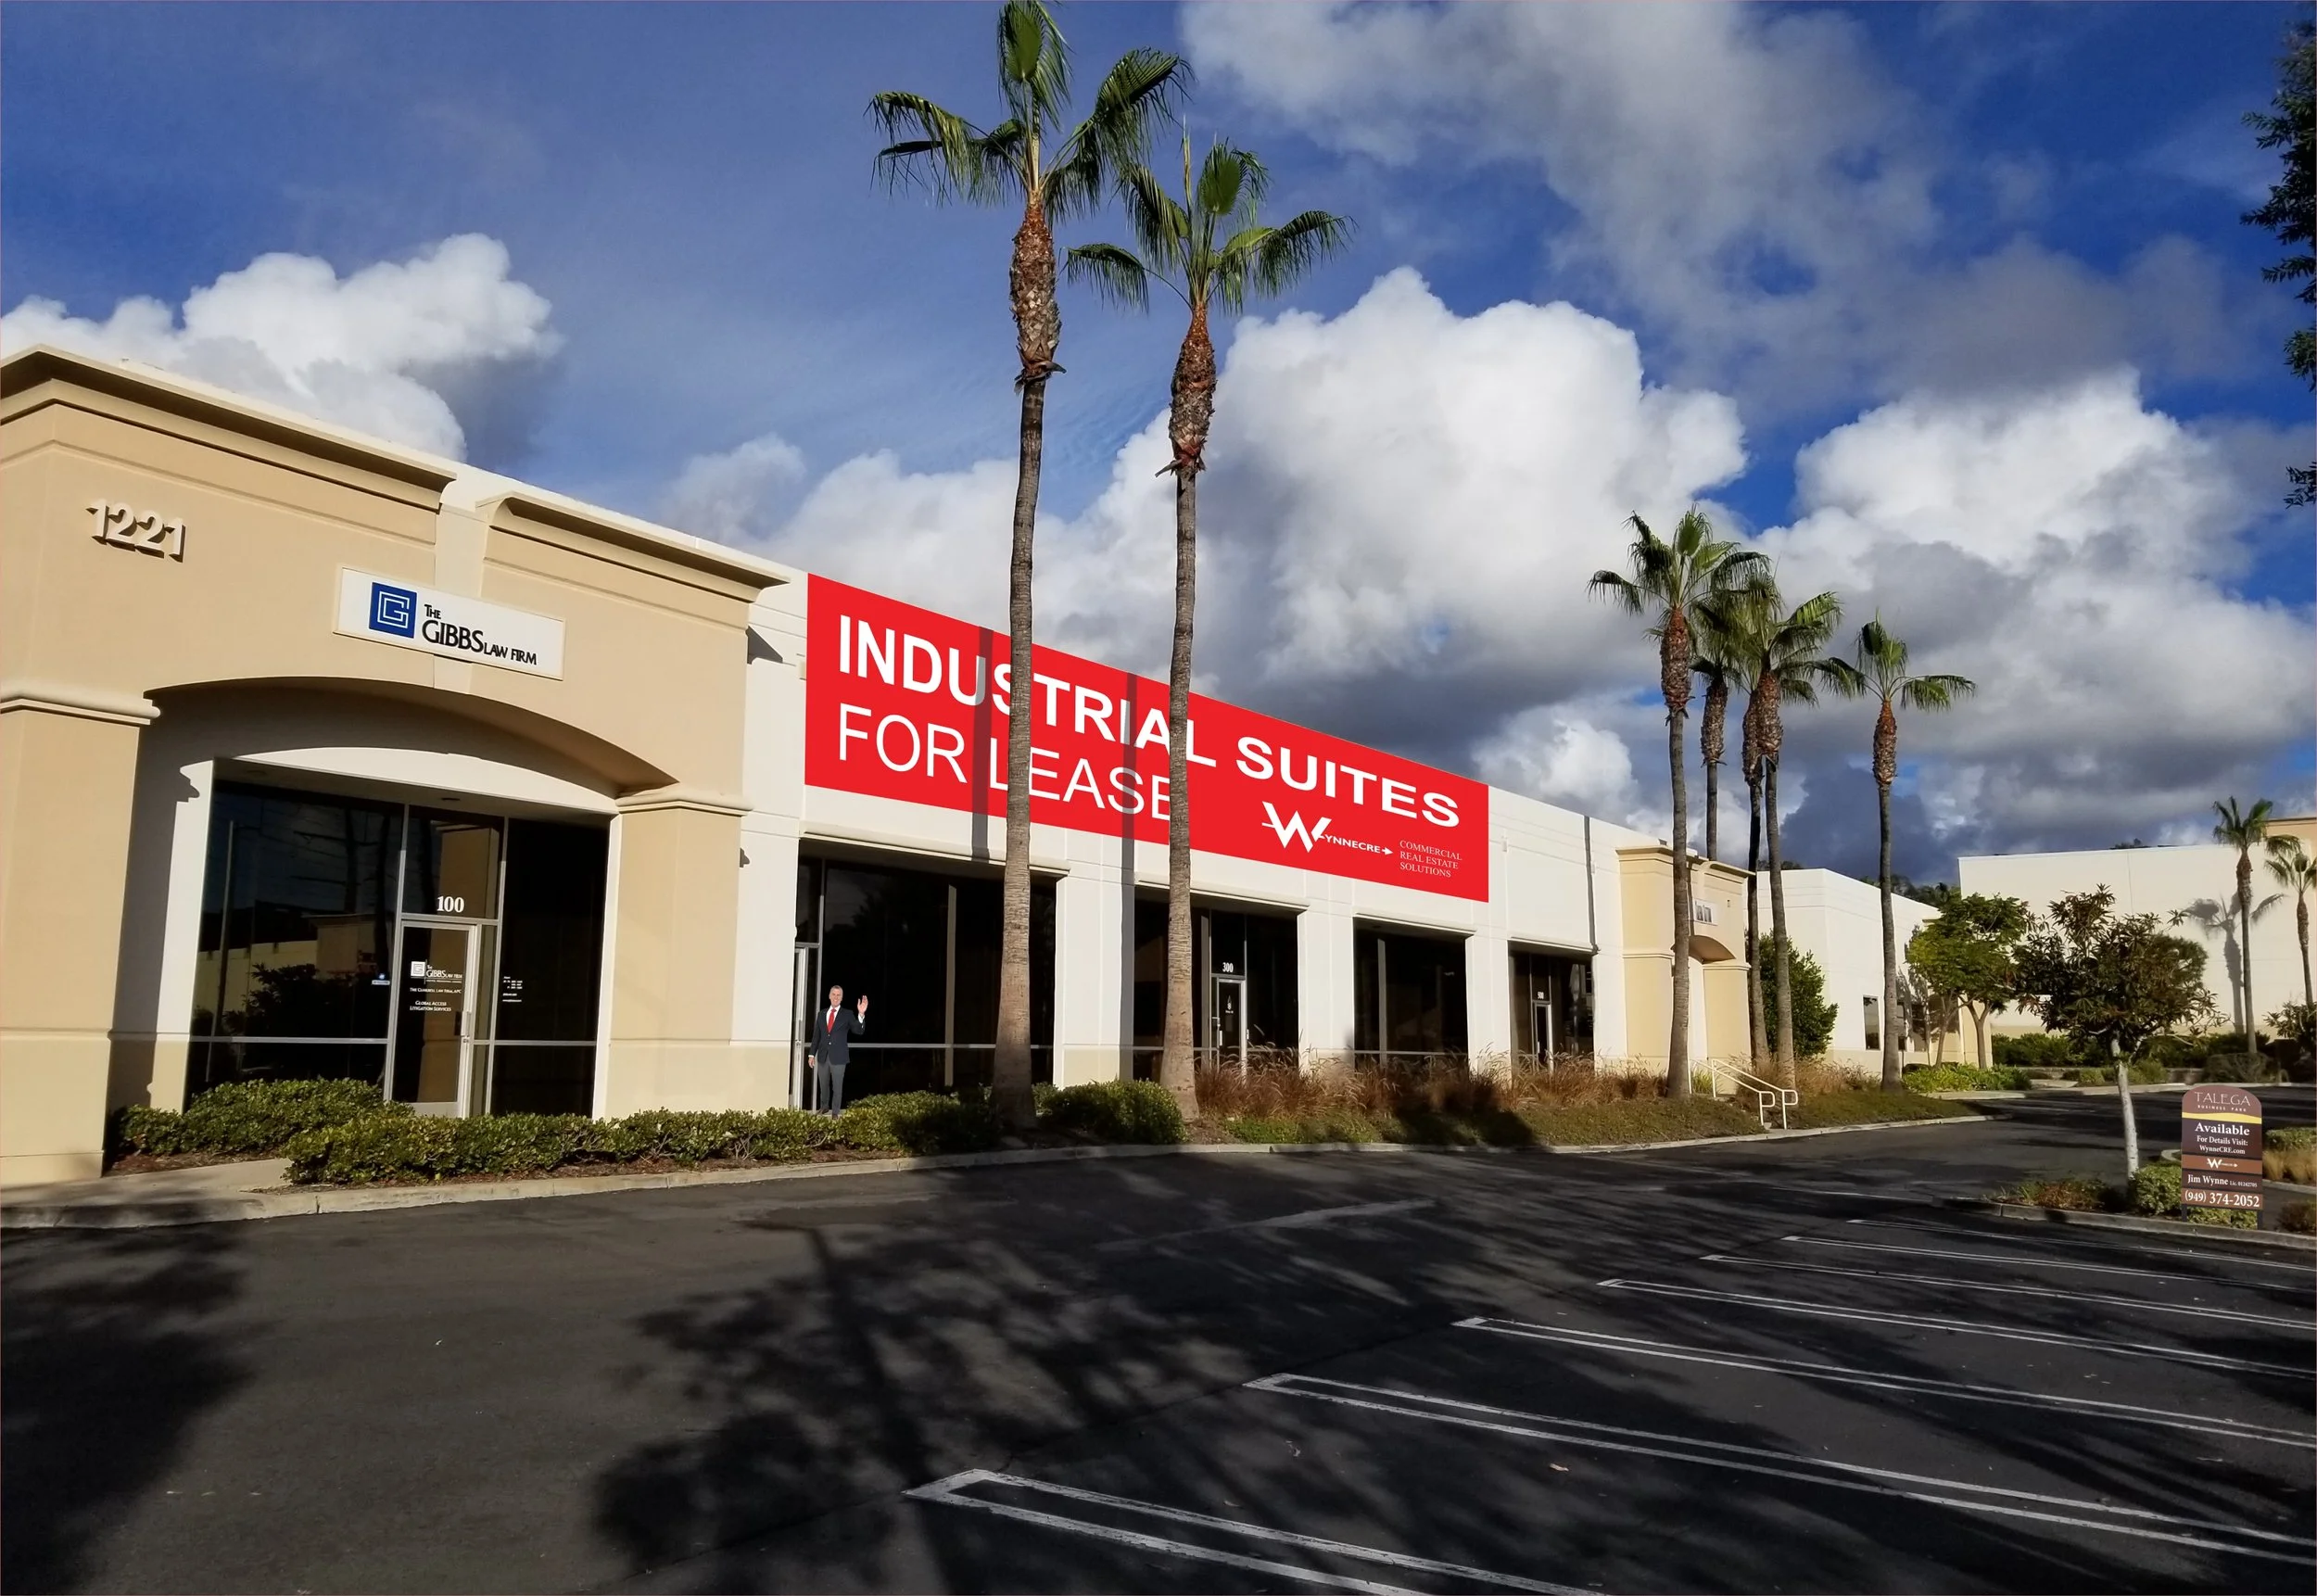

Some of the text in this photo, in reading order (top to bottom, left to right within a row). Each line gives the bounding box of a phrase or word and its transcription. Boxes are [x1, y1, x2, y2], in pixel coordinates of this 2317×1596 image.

[87, 499, 185, 562] 1221
[424, 603, 441, 620] THE
[422, 620, 538, 665] GIBBS LAW FIRM
[840, 614, 1460, 828] INDUSTRIAL SUITES
[839, 703, 1171, 821] FOR LEASE
[1399, 840, 1462, 861] COMMERCIAL
[1399, 851, 1459, 869] REAL ESTATE
[1399, 862, 1451, 878] SOLUTIONS
[437, 895, 464, 913] 100
[426, 969, 446, 978] GIBBS
[1222, 962, 1234, 972] 300
[2195, 1092, 2250, 1107] TALEGA
[2195, 1121, 2250, 1135] Available
[2209, 1136, 2230, 1145] Details
[2199, 1145, 2246, 1154] WynneCRE.com
[2187, 1173, 2200, 1184] Jim
[2202, 1175, 2229, 1186] Wynne
[2184, 1190, 2260, 1208] (949) 374-2052
